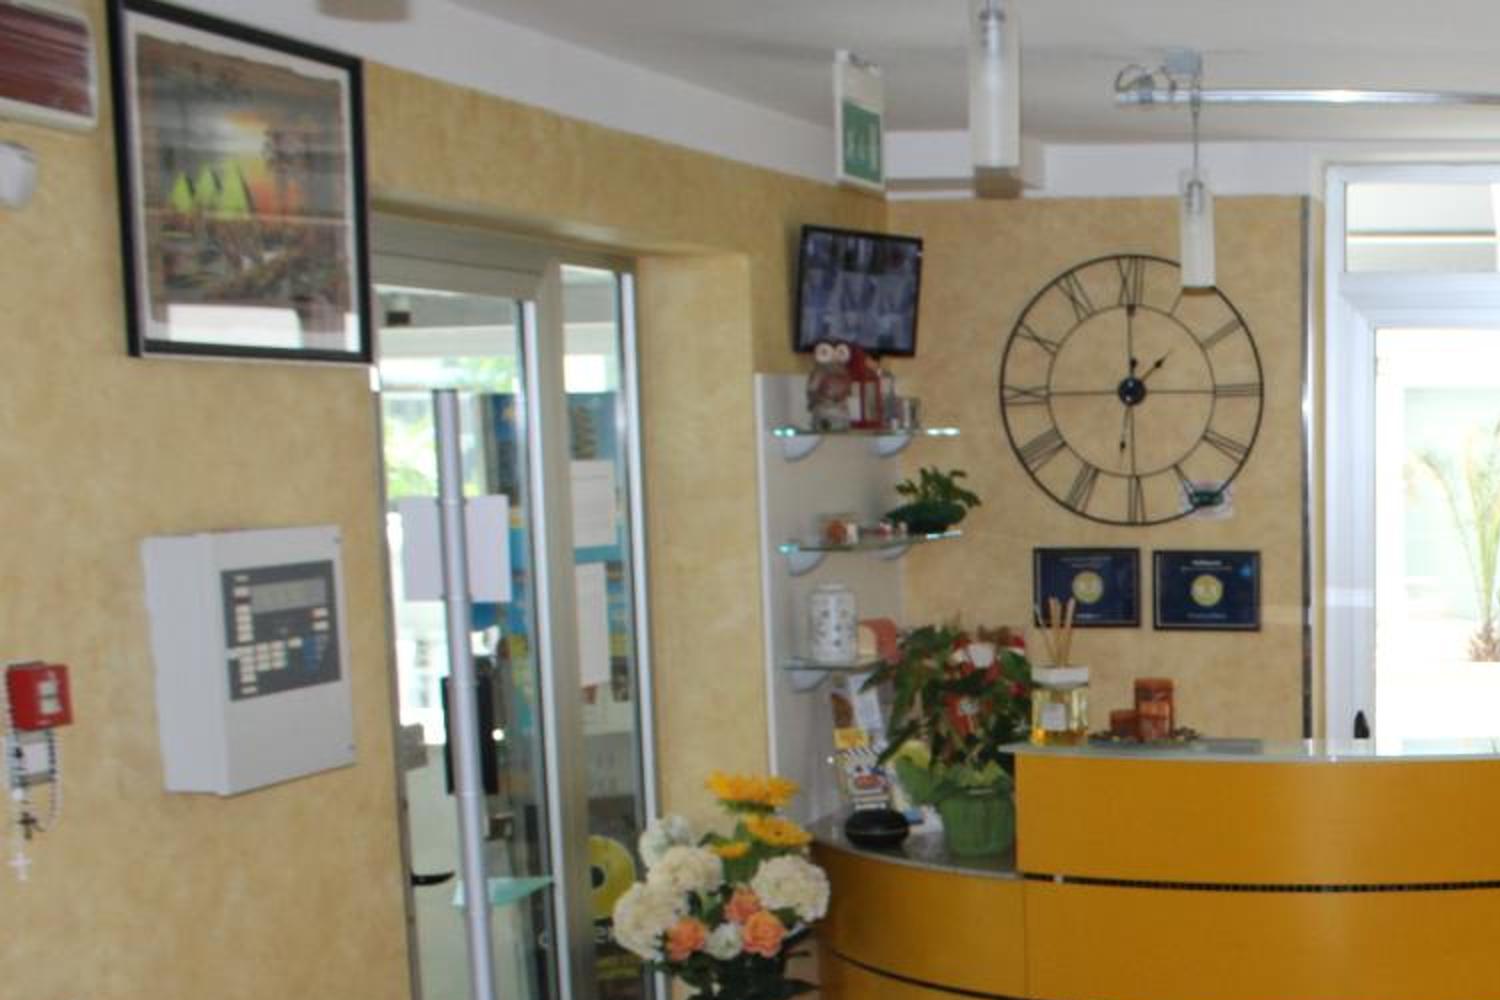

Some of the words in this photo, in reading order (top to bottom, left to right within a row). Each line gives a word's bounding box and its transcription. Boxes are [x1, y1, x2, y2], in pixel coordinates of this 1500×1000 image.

[1055, 270, 1096, 323] XI
[1115, 257, 1146, 306] XII
[1013, 322, 1060, 353] X
[1002, 383, 1051, 406] IX
[1214, 383, 1263, 398] III
[1127, 476, 1147, 524] VI
